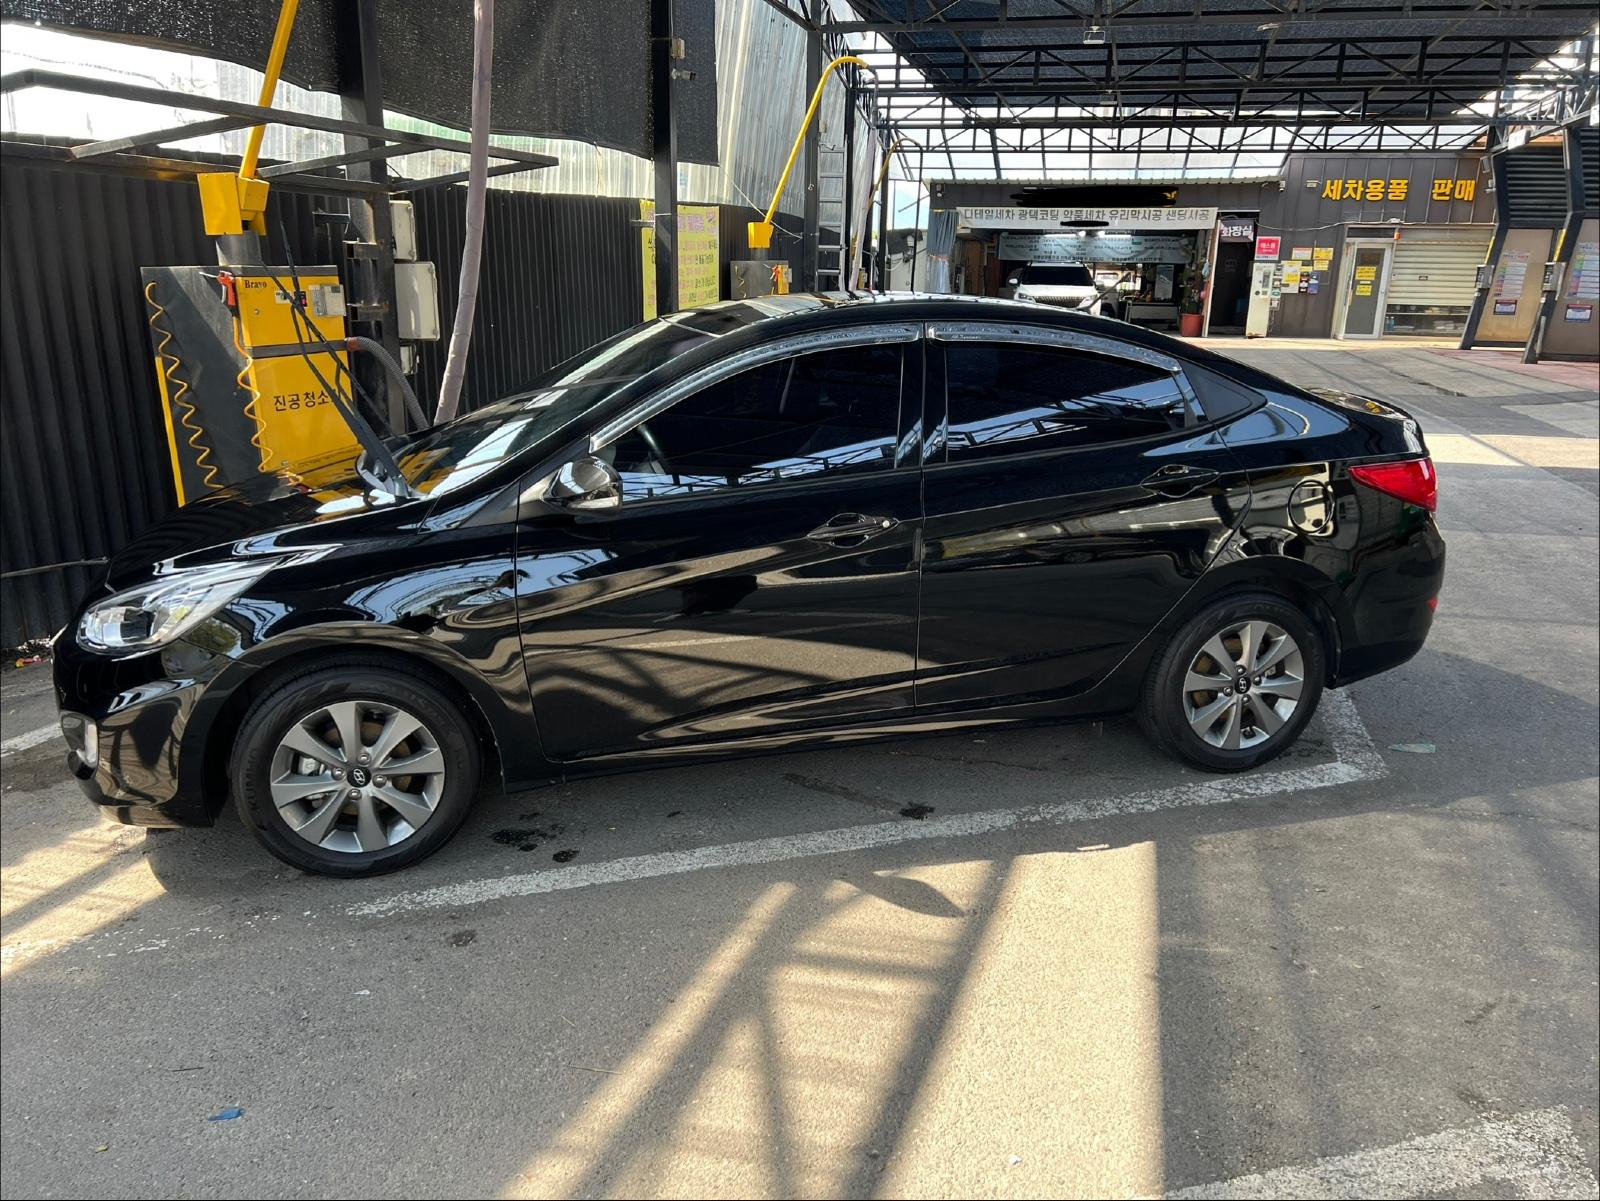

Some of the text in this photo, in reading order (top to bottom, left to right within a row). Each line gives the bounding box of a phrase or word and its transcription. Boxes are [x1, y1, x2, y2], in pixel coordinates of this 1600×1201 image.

[1321, 179, 1476, 201] 세차용품 판매
[964, 208, 1016, 221] 디테일세차
[1063, 209, 1106, 221] 약품세차
[1108, 209, 1163, 221] 유리막시공
[1165, 209, 1210, 221] 샌딩시공
[1220, 225, 1253, 237] 화장실
[244, 279, 268, 289] Bravo
[273, 390, 333, 411] 진공청소
